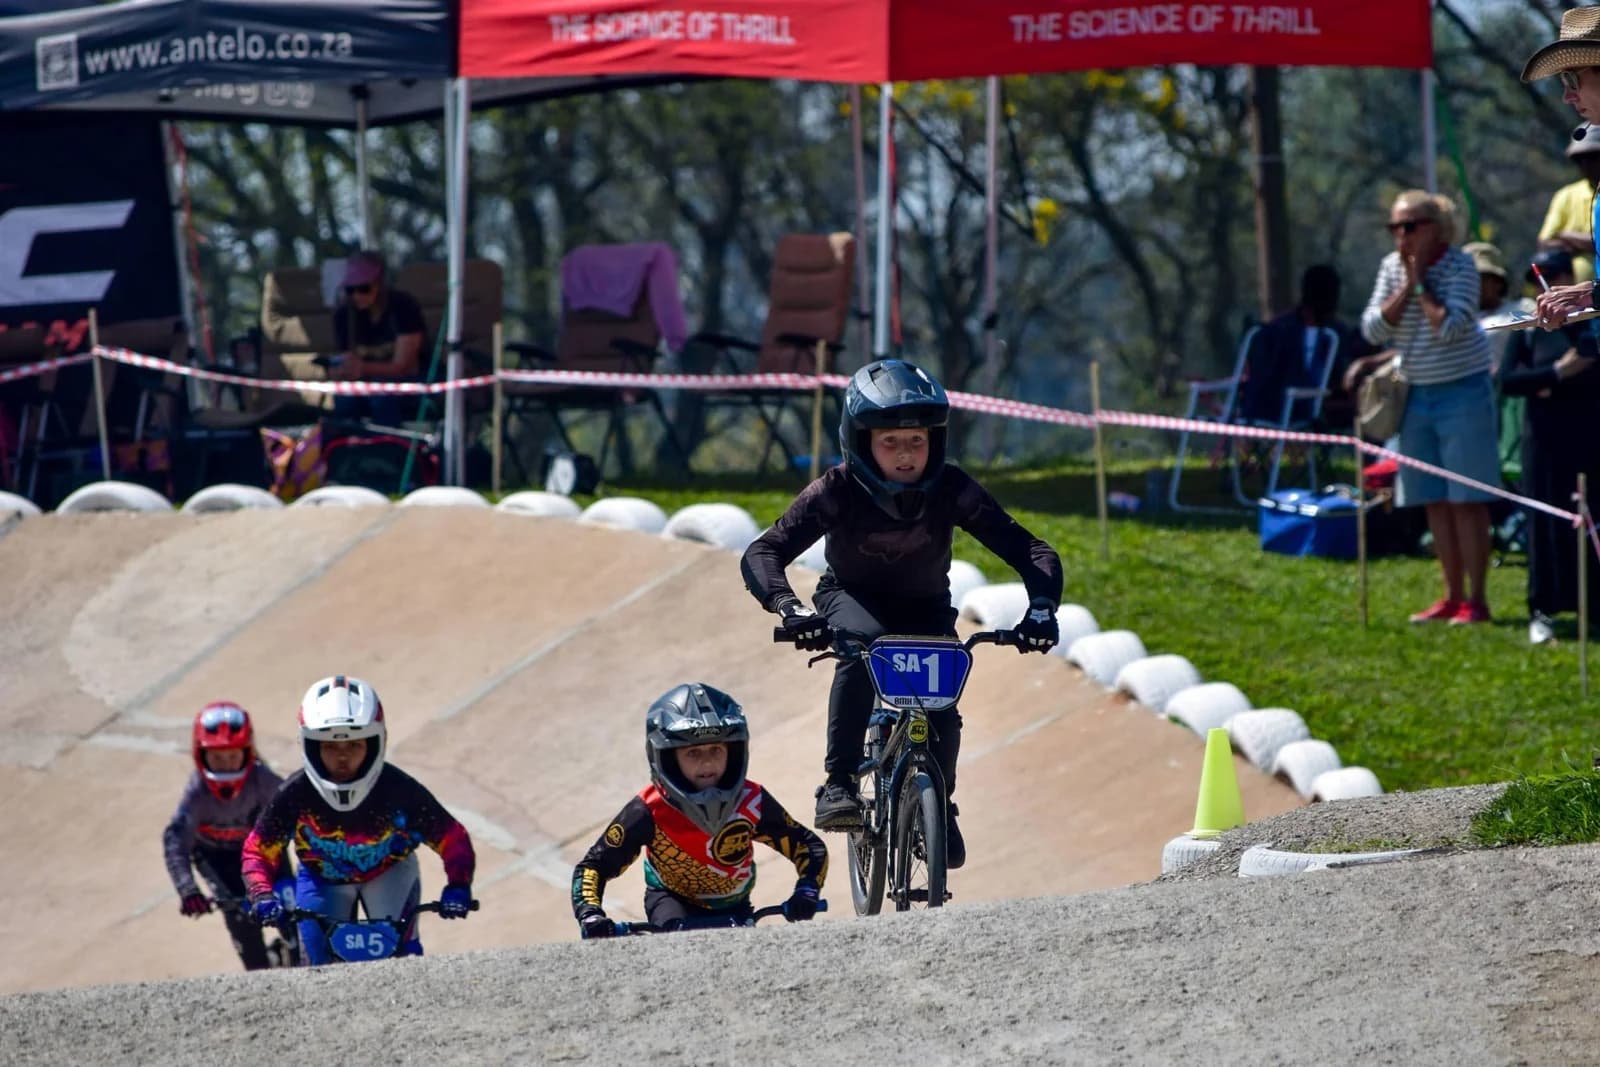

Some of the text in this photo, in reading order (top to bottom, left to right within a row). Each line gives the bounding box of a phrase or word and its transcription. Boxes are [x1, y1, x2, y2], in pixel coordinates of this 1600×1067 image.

[548, 11, 795, 45] THE SCIENCE OF THRILL
[1010, 4, 1321, 42] THE SCIENCE OF THRILL
[85, 26, 353, 74] www.antelo.co.za
[892, 653, 939, 693] SA 1
[345, 933, 384, 956] SA 5
